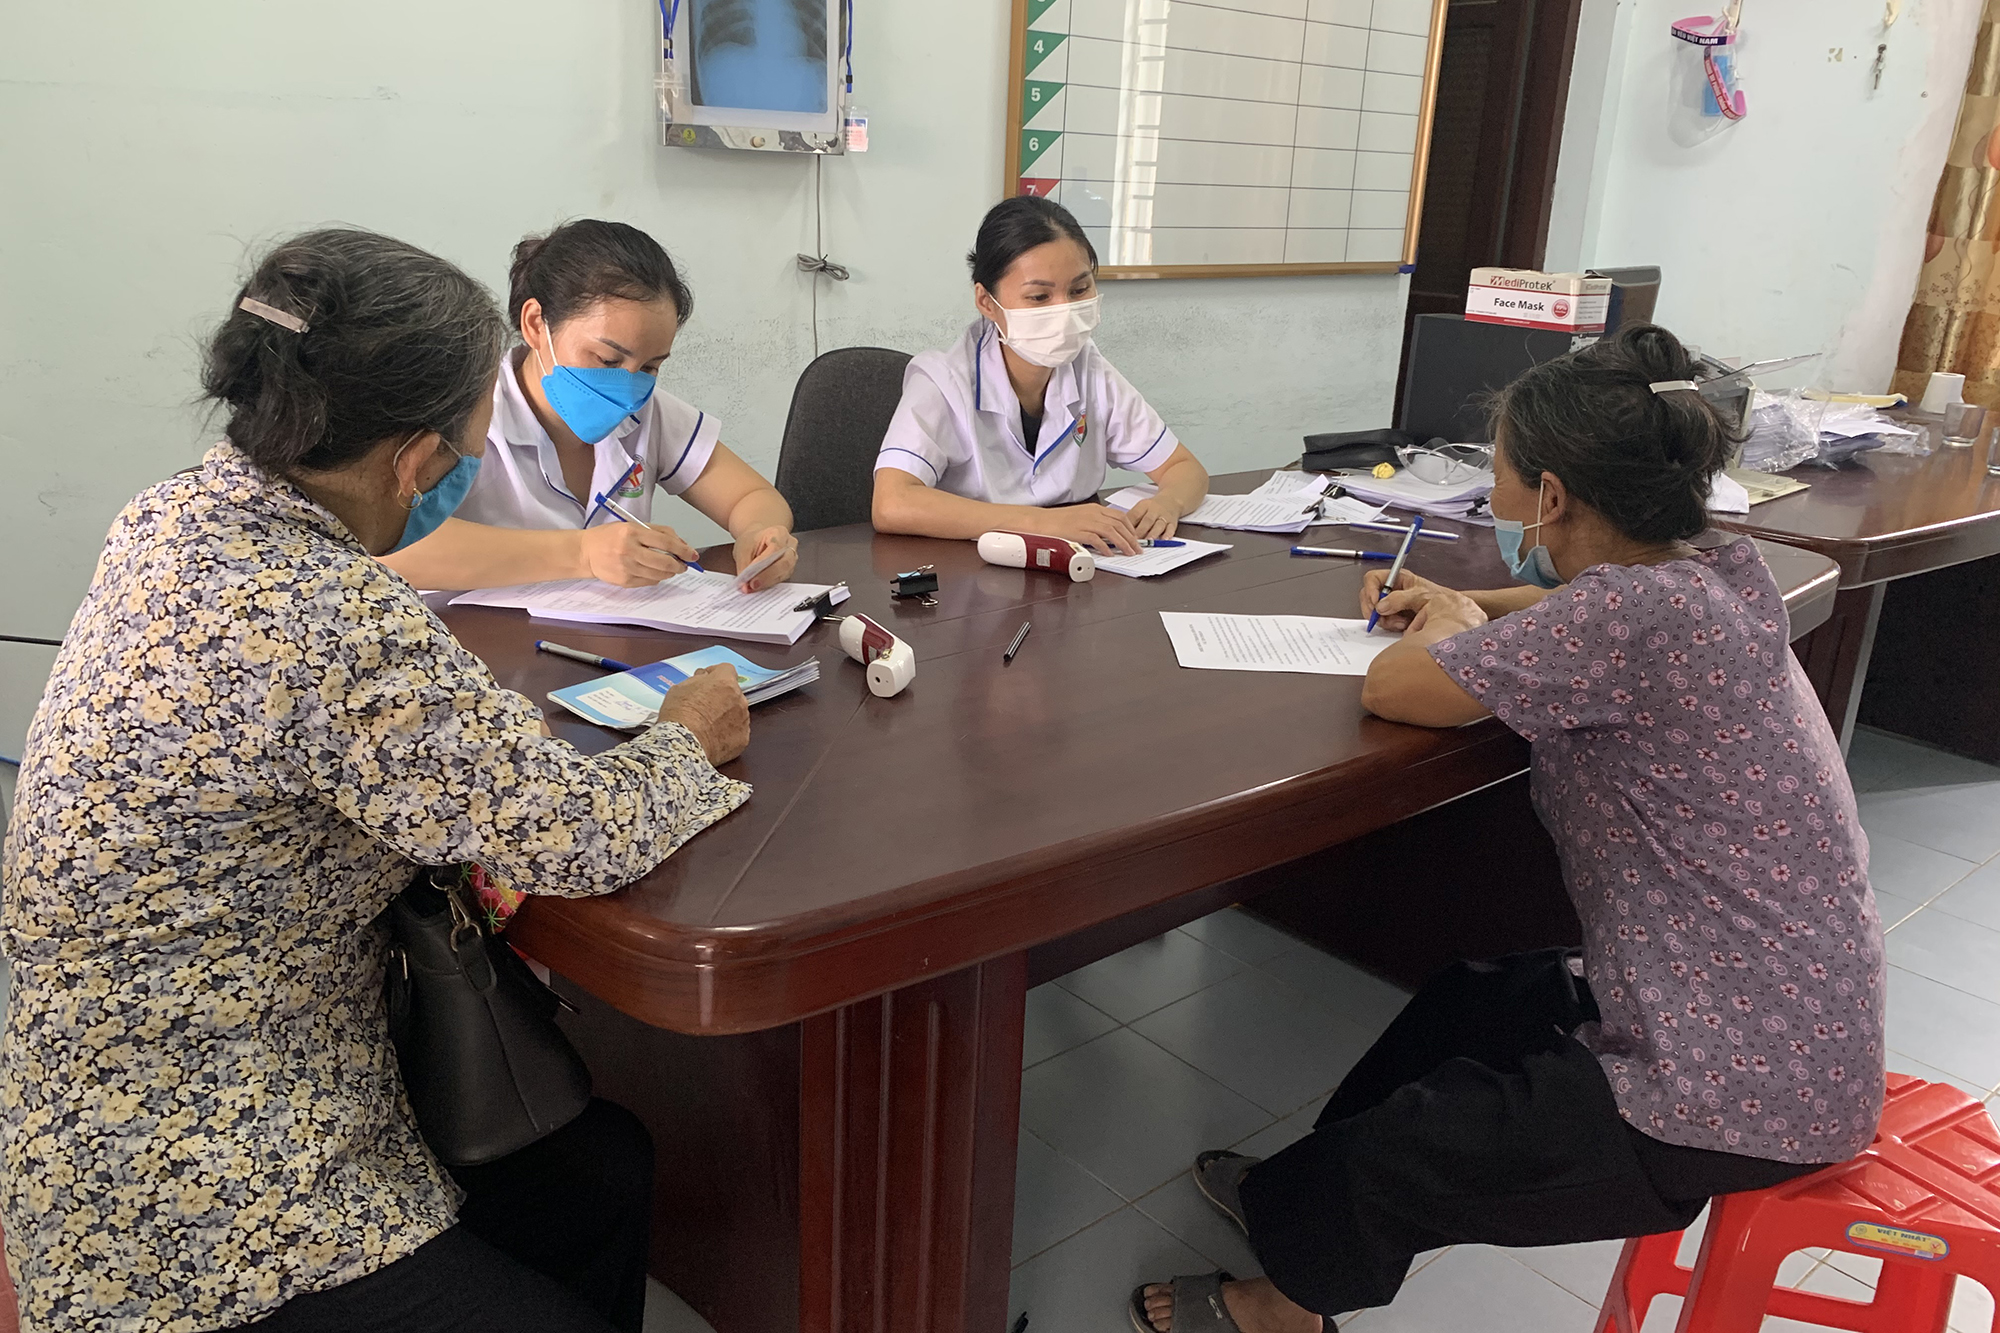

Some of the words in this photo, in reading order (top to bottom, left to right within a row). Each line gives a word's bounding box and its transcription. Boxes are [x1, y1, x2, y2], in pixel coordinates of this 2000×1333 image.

[1033, 39, 1045, 54] 4
[1699, 37, 1719, 45] NAM
[1030, 87, 1041, 102] 5
[1028, 137, 1039, 151] 6
[1026, 184, 1037, 196] 7
[1490, 275, 1552, 291] MediProtek
[1493, 297, 1516, 309] Face
[1517, 300, 1545, 312] Mask
